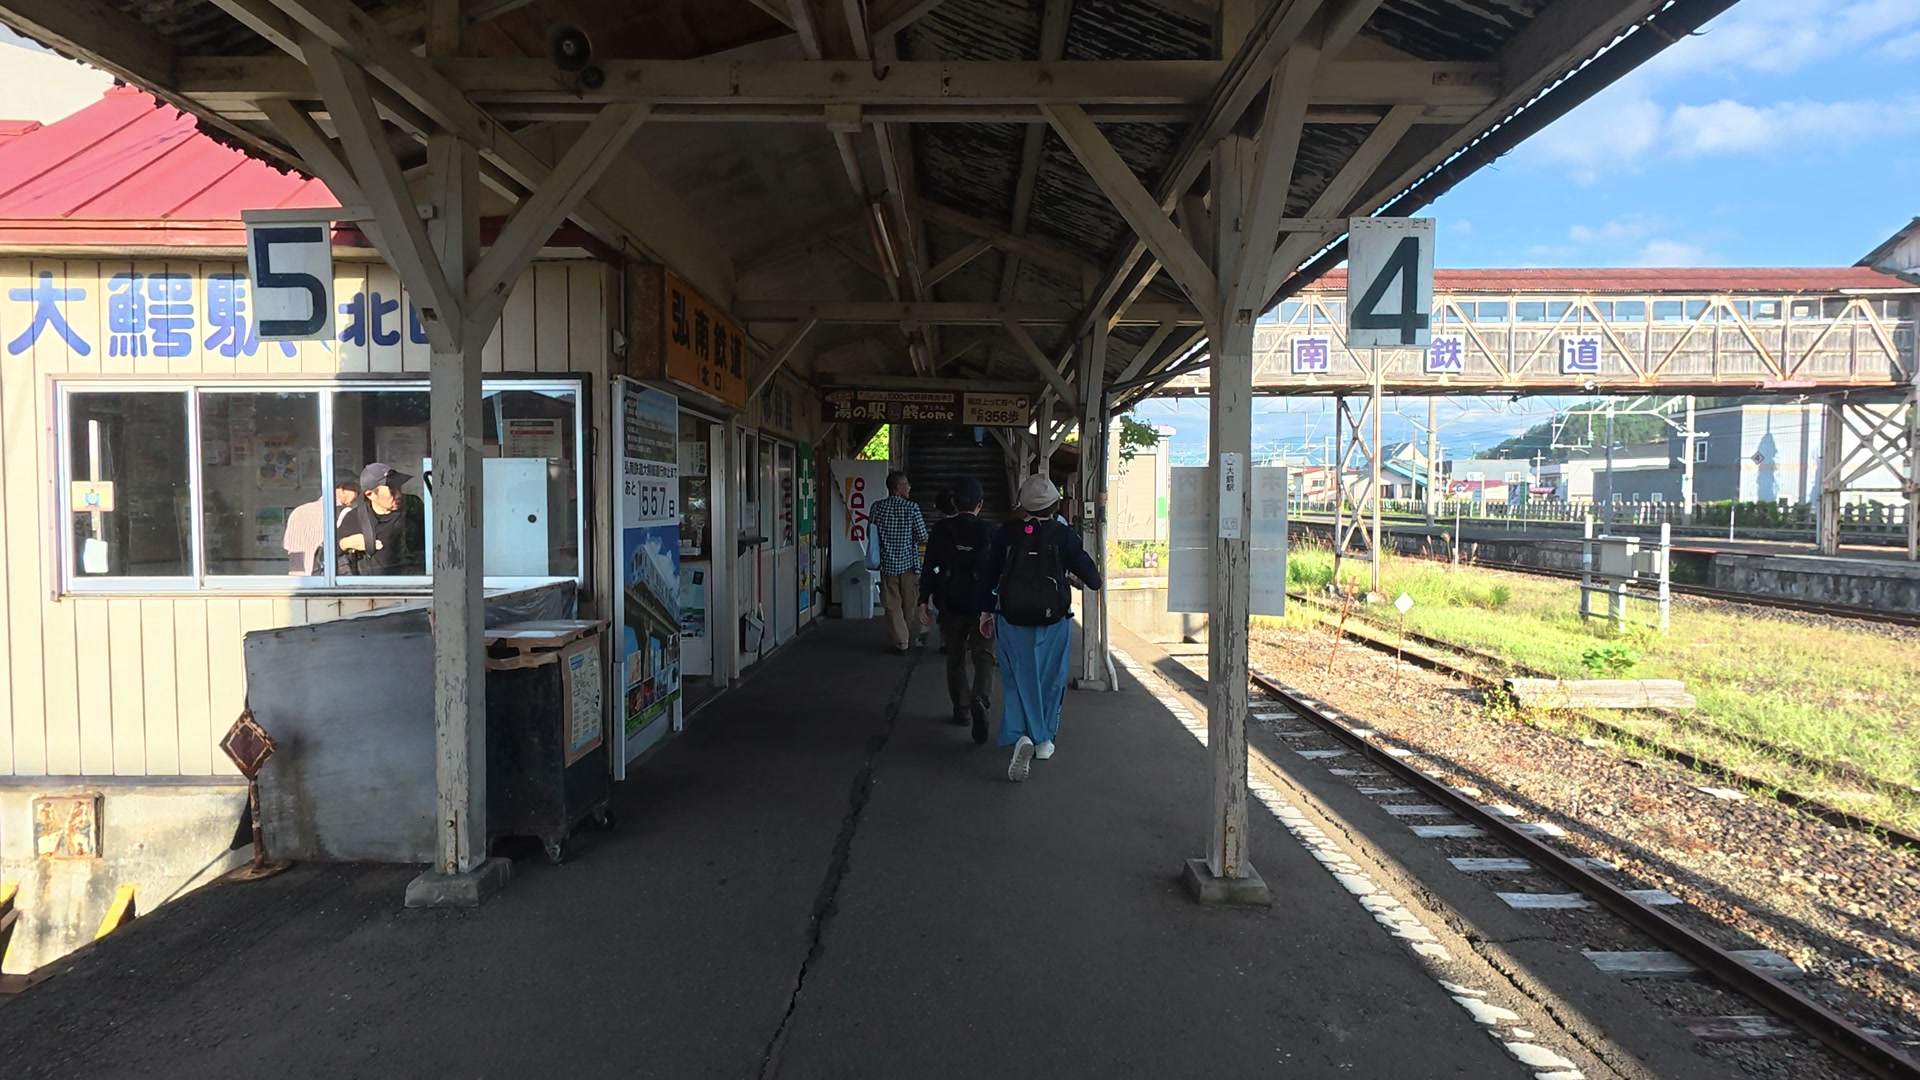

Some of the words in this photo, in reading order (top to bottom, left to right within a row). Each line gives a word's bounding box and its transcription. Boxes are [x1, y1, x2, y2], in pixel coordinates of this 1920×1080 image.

[254, 227, 327, 337] 5
[1351, 236, 1430, 345] 4
[834, 402, 886, 420] 湯の駅
[851, 477, 869, 541] DyDo
